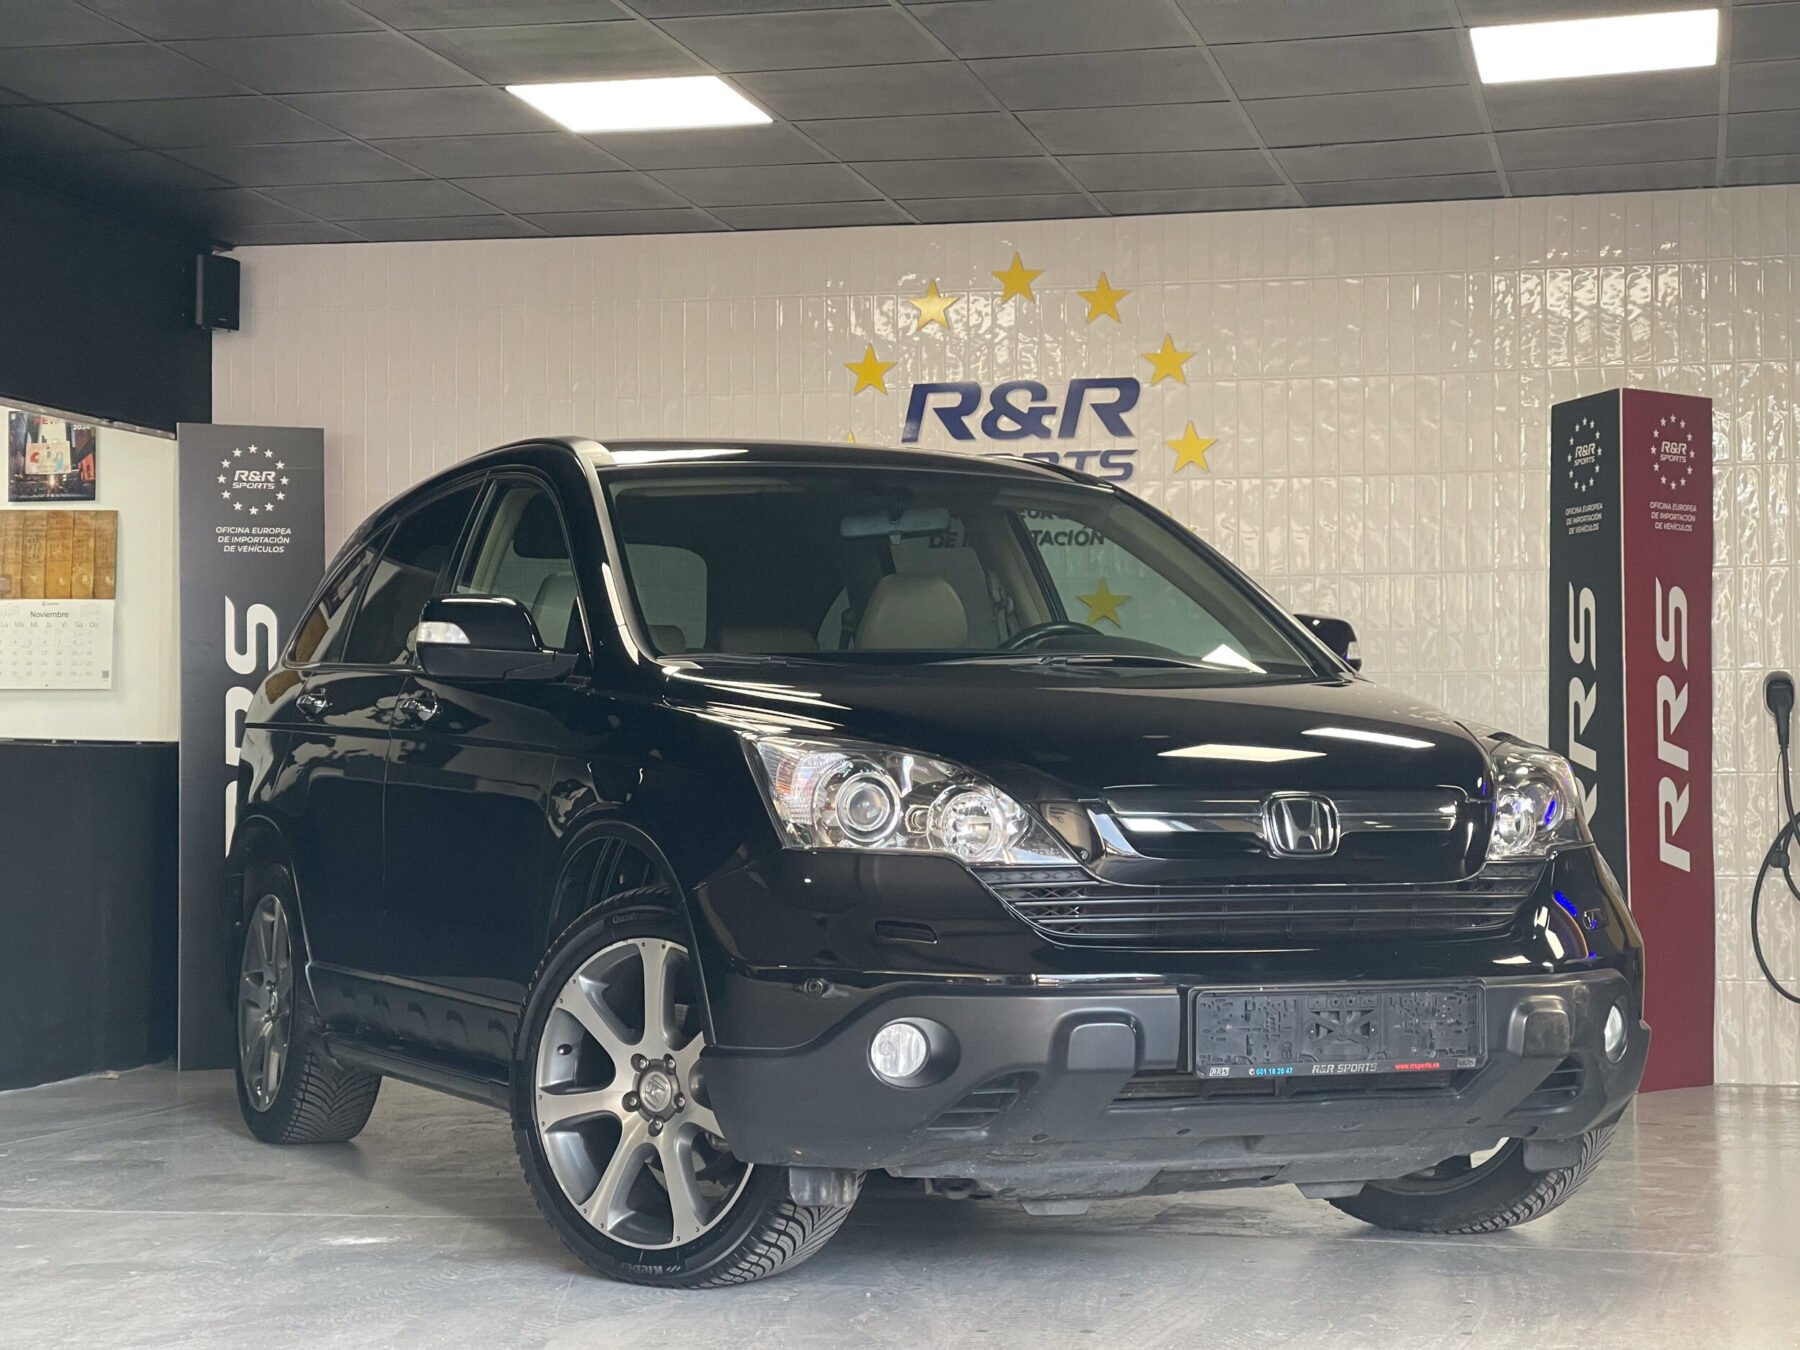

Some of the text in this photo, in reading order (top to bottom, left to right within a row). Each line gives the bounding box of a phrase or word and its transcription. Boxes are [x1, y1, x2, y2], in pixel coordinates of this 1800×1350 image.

[902, 377, 1141, 443] R&R
[1574, 443, 1596, 458] R&R
[1661, 441, 1687, 455] R&R
[1574, 455, 1595, 466] SPORTS
[1660, 454, 1687, 463] SPORTS
[234, 470, 276, 482] R&R
[232, 482, 275, 490] SPORTS
[1565, 502, 1603, 516] OFICINA EUROPEA
[1650, 502, 1697, 512] OFICINA EUROPEA
[216, 526, 291, 535] OFICINA EUROPEA
[217, 535, 290, 544] DE IMPORTACIÓN
[223, 545, 236, 553] DE
[1655, 576, 1691, 873] RRS
[1337, 1063, 1378, 1073] SPORTS
